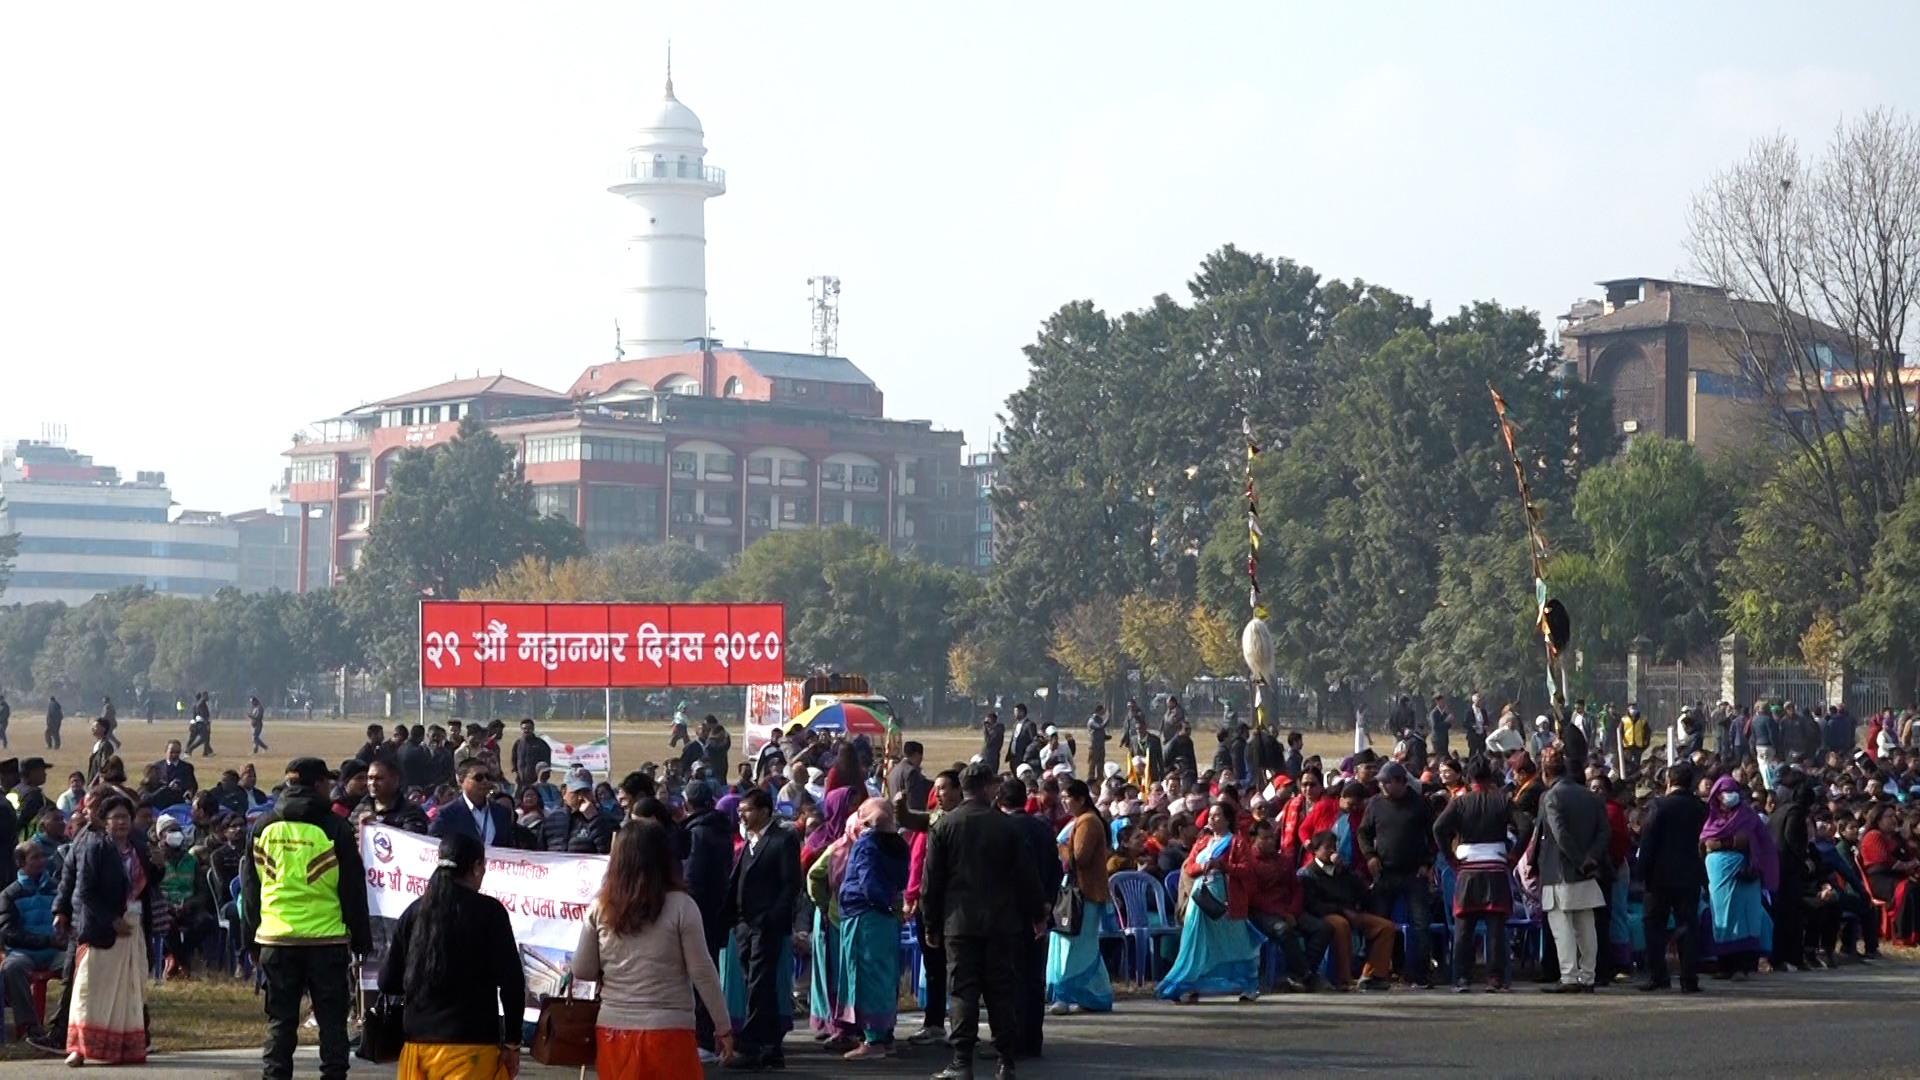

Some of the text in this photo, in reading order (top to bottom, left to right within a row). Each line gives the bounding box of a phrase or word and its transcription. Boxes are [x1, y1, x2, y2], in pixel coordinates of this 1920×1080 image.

[517, 632, 628, 670] महानगर
[636, 622, 705, 668] दिवस
[713, 631, 781, 668] २०८०
